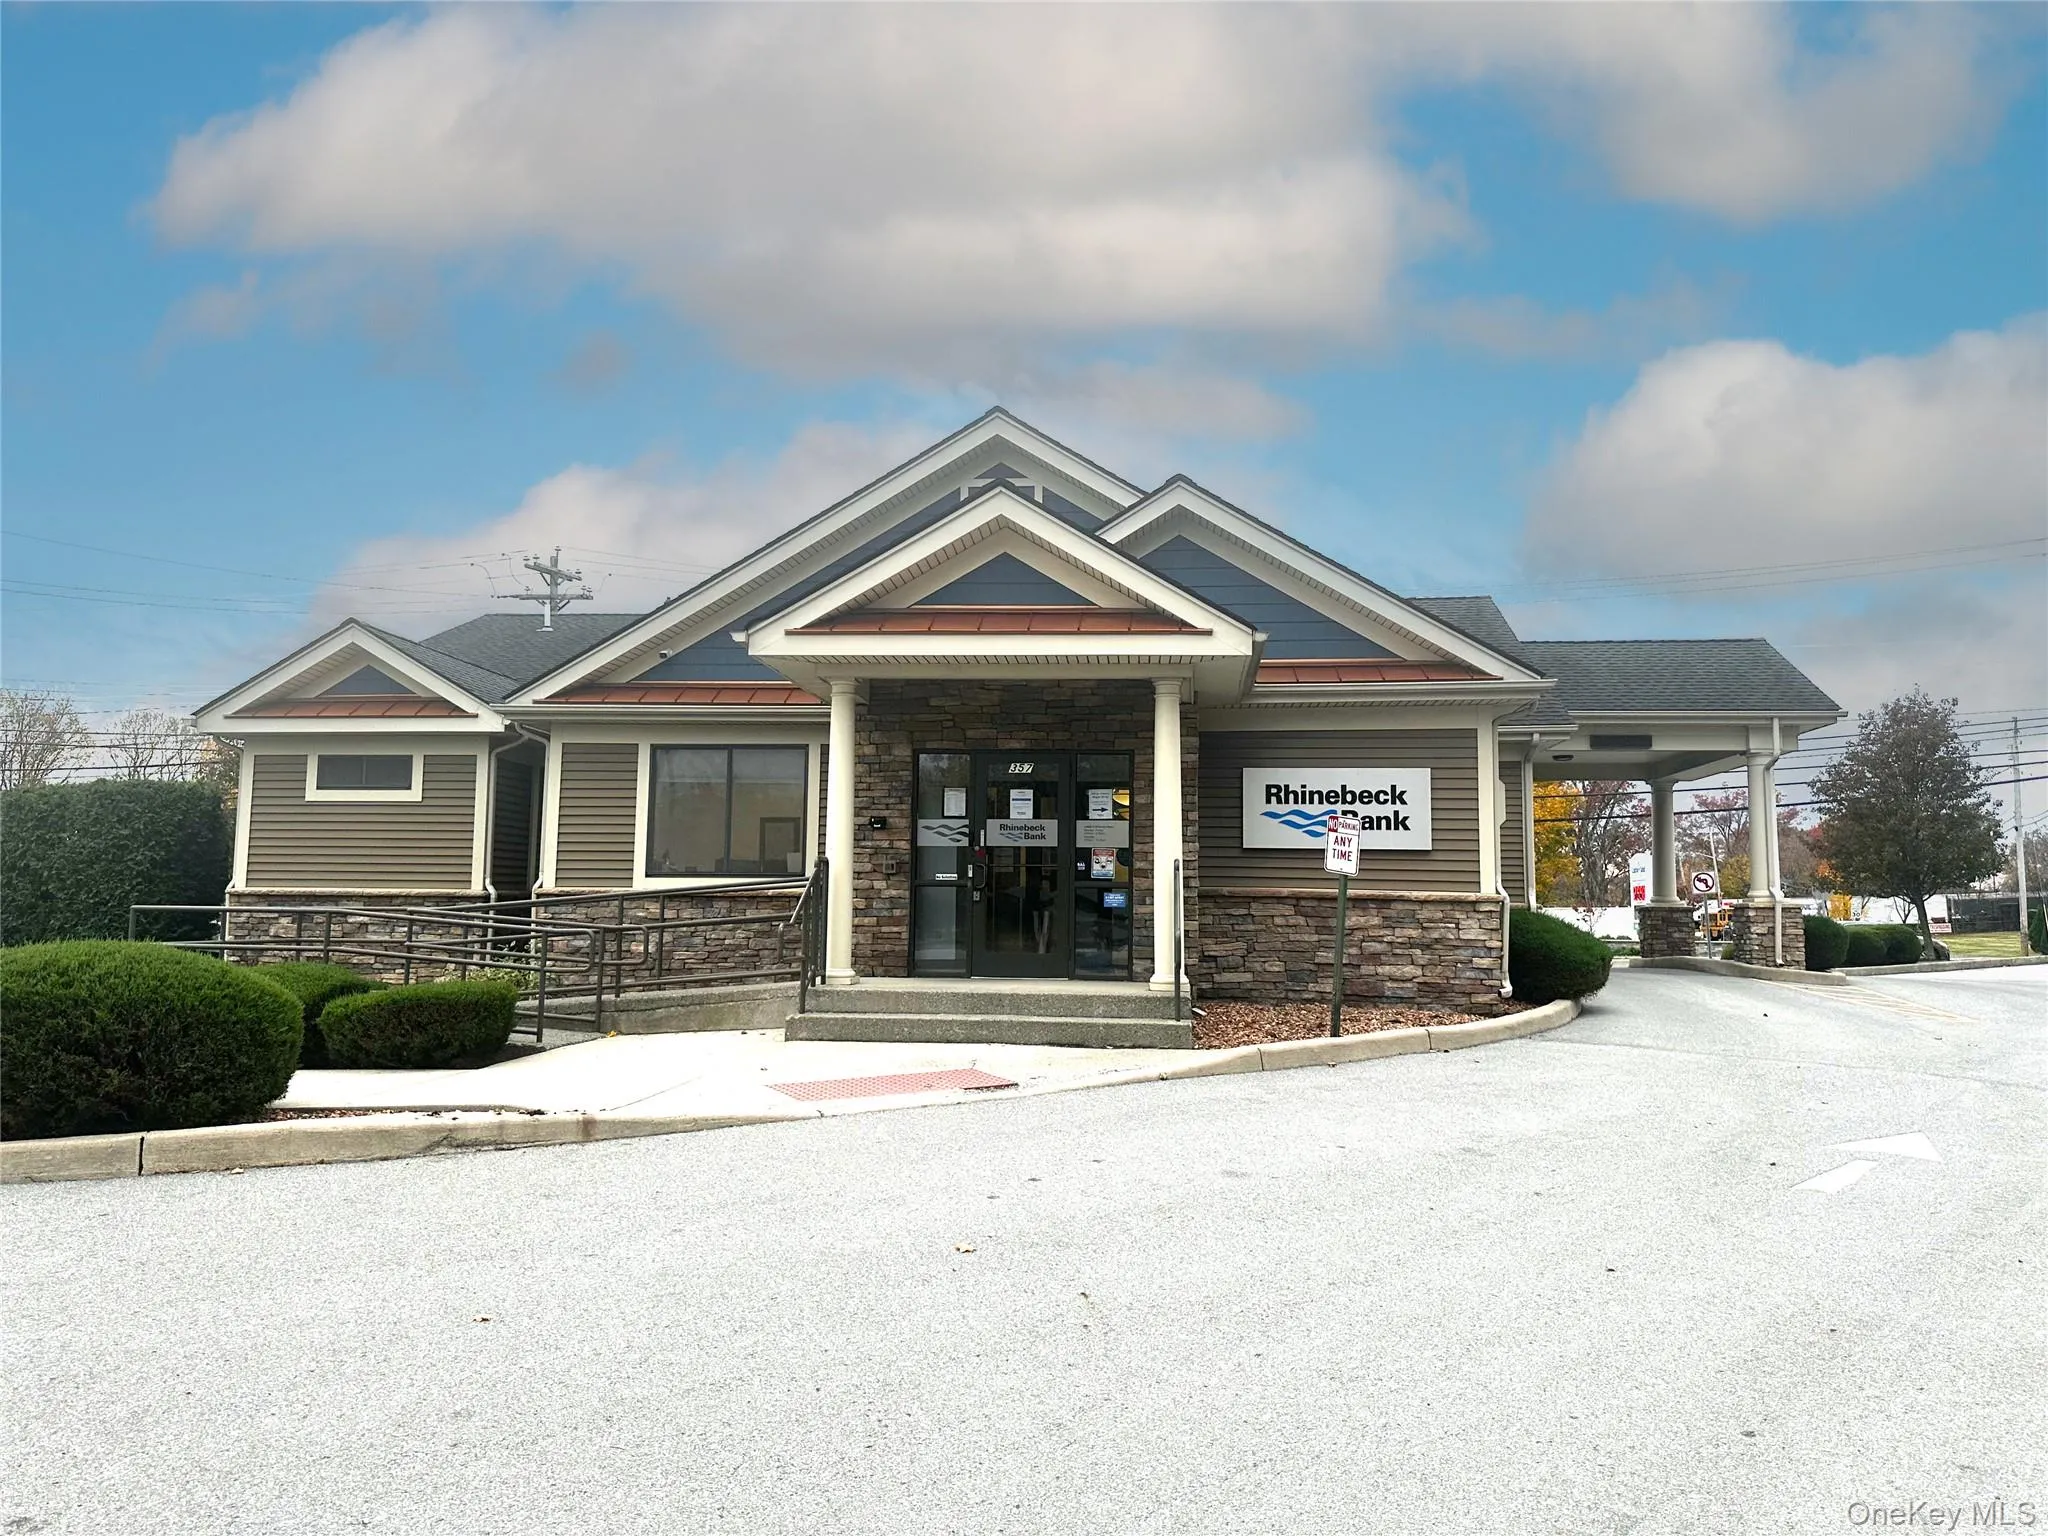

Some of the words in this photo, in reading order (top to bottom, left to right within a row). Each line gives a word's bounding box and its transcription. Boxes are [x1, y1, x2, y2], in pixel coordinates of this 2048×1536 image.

[1010, 763, 1033, 773] 357
[1265, 784, 1408, 805] Rhinebeck
[999, 823, 1046, 831] Rhinebeck
[1328, 818, 1338, 831] NO
[1338, 820, 1359, 832] PARKING
[1023, 832, 1046, 840] Bank
[1333, 835, 1353, 848] ANY
[1332, 848, 1353, 862] TIME
